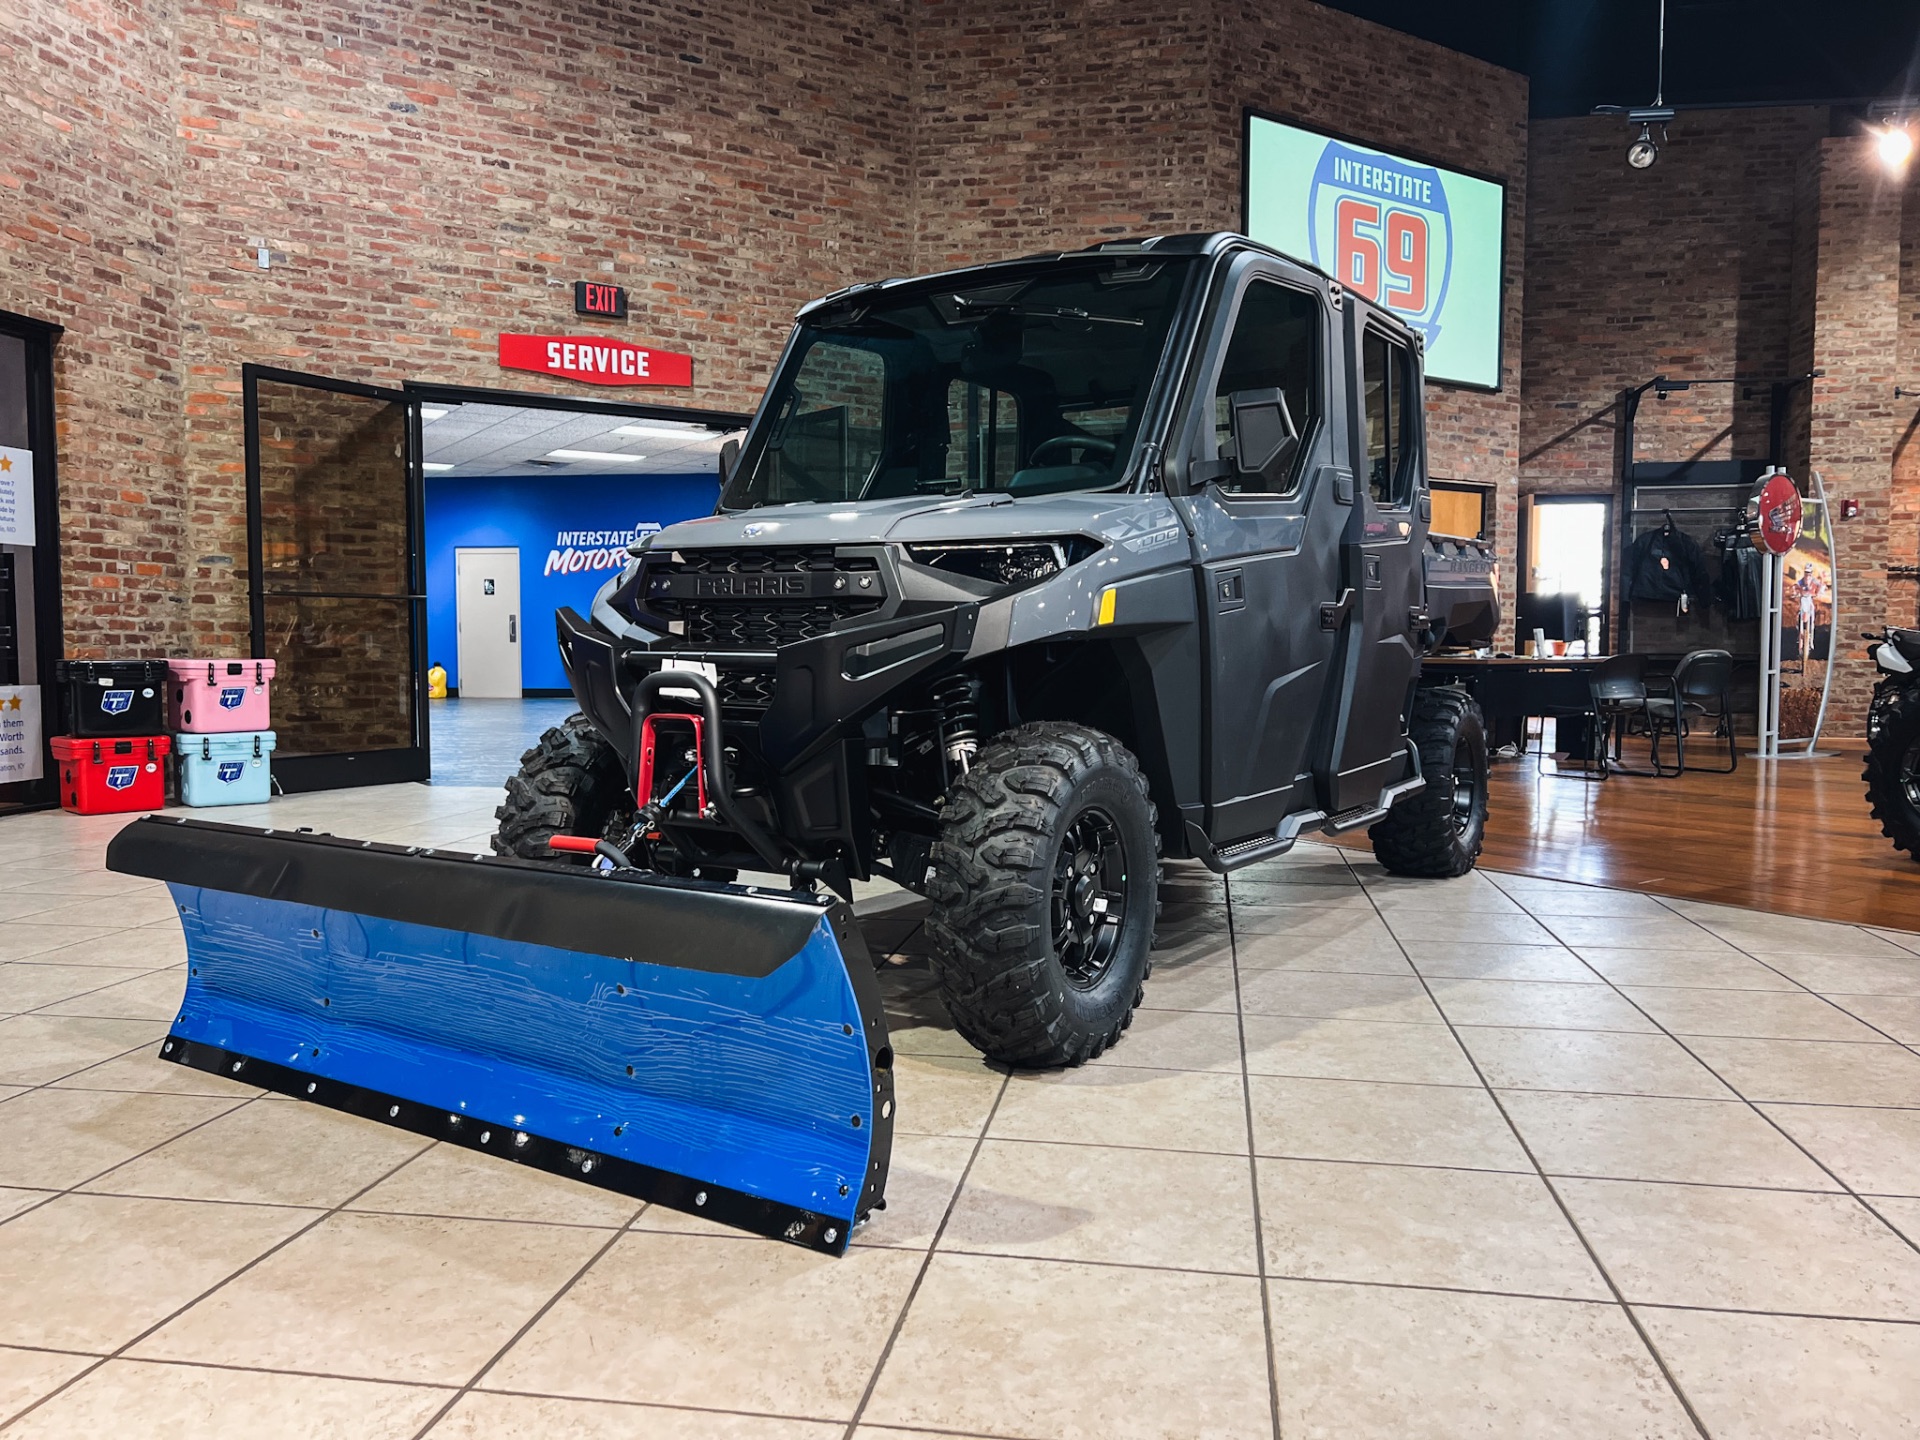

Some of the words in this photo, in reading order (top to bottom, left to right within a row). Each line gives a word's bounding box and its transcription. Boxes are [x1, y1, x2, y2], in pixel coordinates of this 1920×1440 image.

[1334, 156, 1432, 204] INTERSTATE
[1334, 195, 1430, 317] 69
[585, 283, 617, 313] EXIT
[547, 341, 650, 377] SERVICE
[1117, 507, 1170, 538] XP
[556, 530, 634, 546] INTERSTATE
[1450, 561, 1487, 574] RANGER
[696, 576, 806, 596] POLARIS
[3, 718, 24, 729] them
